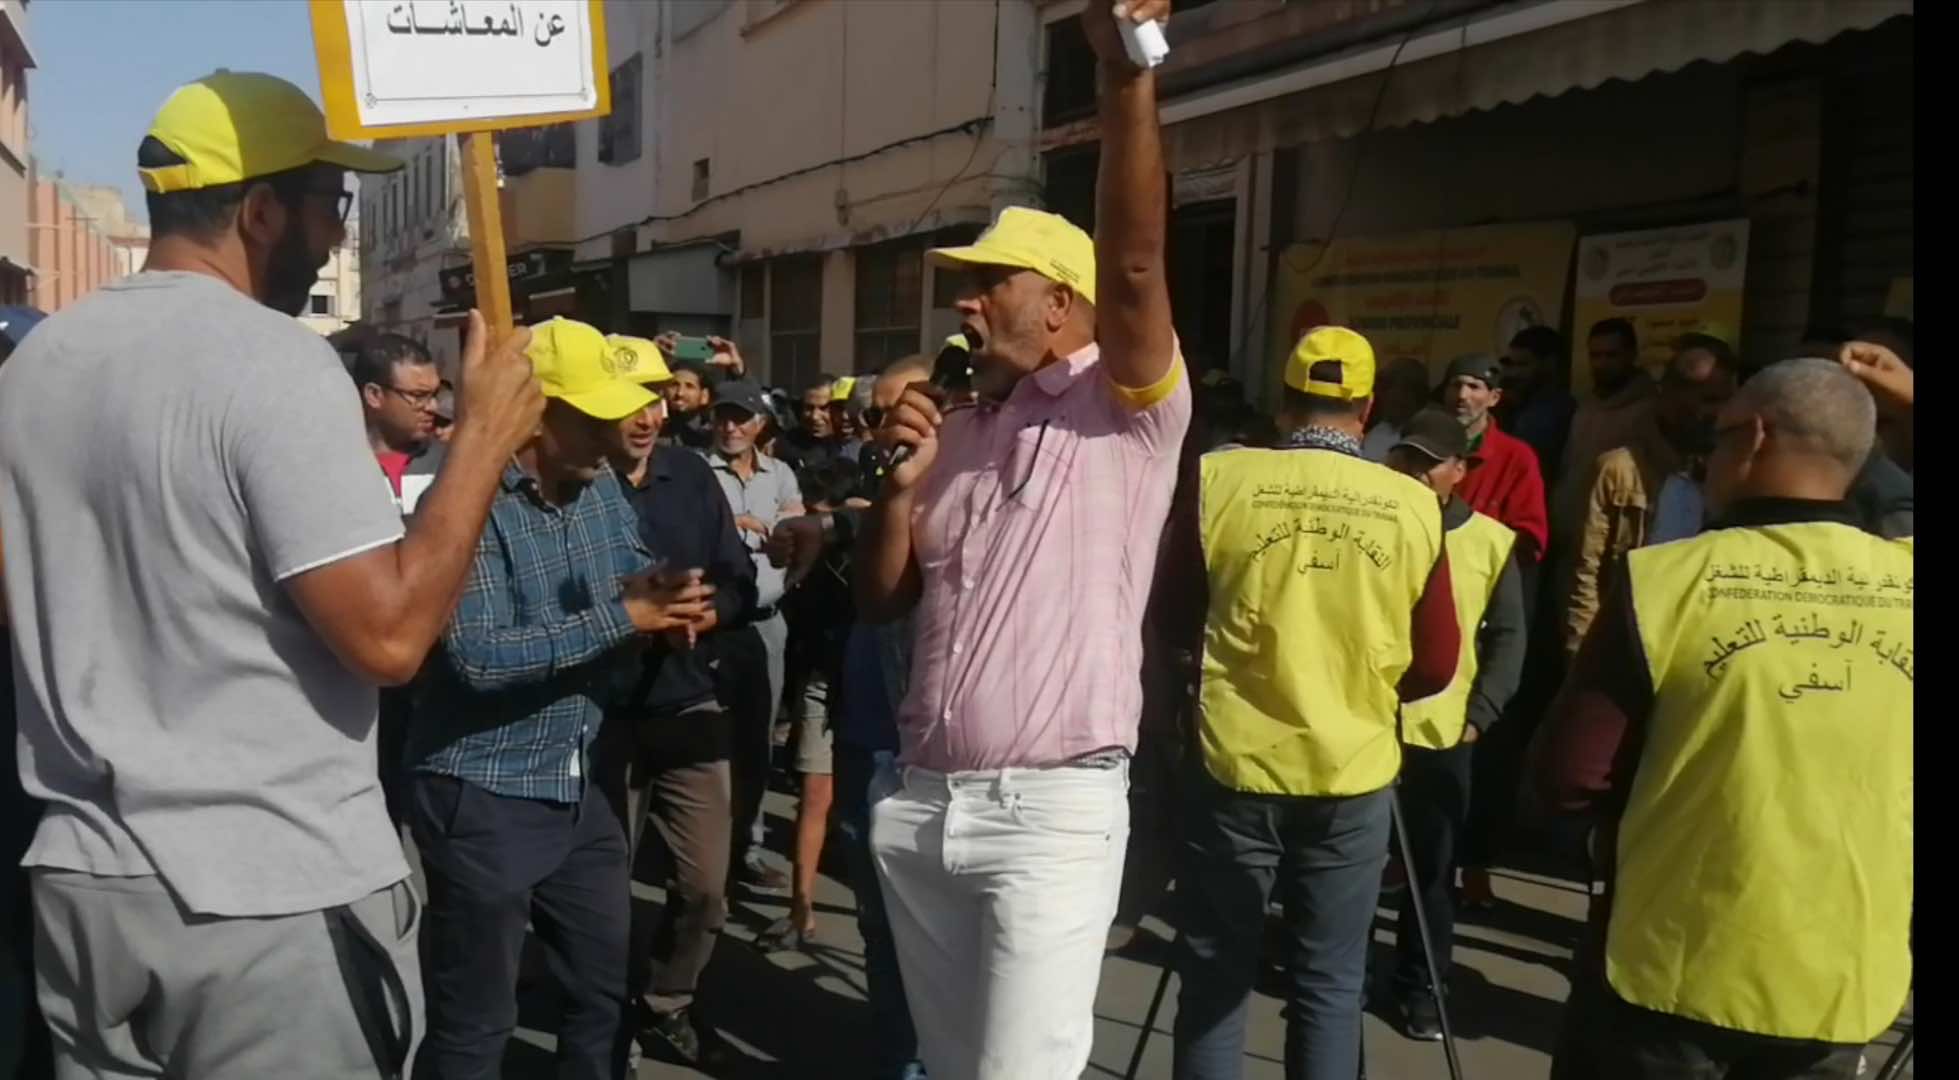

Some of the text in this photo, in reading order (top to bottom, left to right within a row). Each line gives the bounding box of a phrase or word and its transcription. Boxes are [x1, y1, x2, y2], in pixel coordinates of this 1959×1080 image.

[387, 1, 566, 47] عن المعاشات
[1704, 618, 1767, 682] للتعليم
[1773, 611, 1864, 649] الوطنية
